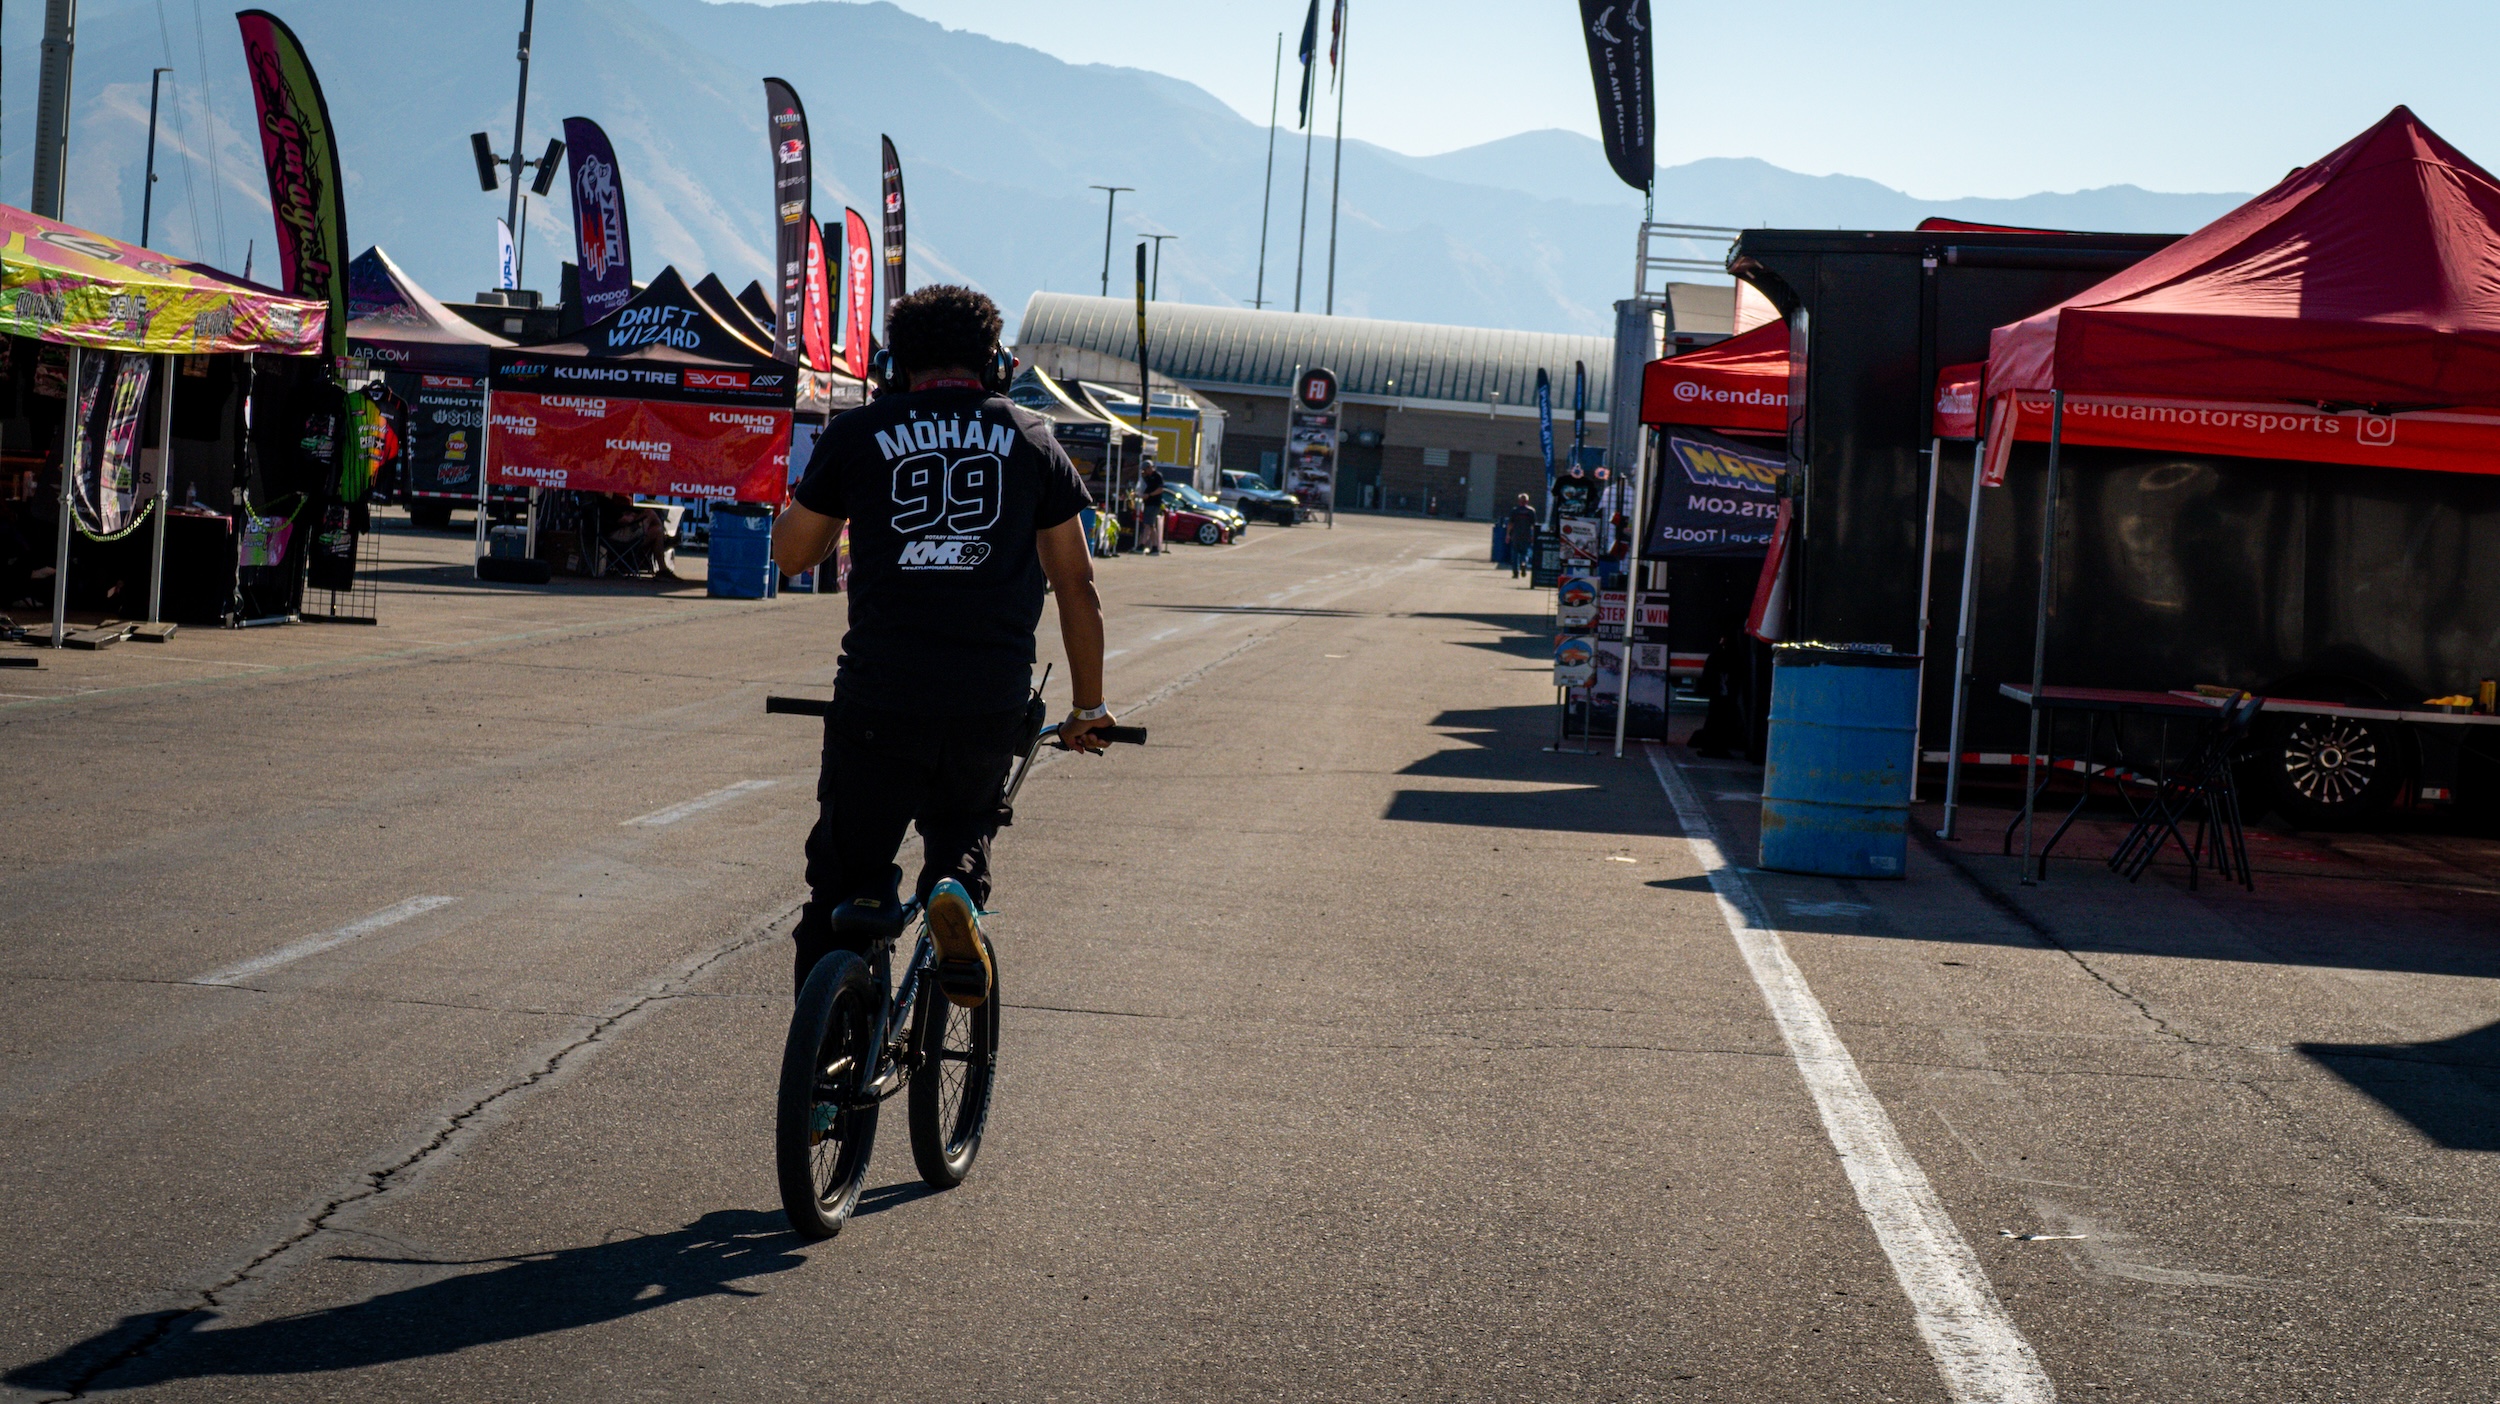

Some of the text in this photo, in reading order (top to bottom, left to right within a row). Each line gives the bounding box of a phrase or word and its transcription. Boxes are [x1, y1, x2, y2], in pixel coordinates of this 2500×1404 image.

[1605, 47, 1618, 75] U.S.
[1634, 65, 1642, 92] AIR
[1610, 76, 1622, 102] AIR
[1635, 94, 1644, 147] FORCE
[602, 189, 619, 265] LINK
[586, 288, 629, 304] VOODOO
[617, 305, 699, 329] DRIFT
[608, 325, 700, 349] WIZARD
[353, 347, 409, 362] AB.COM
[554, 367, 629, 382] KUMHO
[631, 370, 677, 385] TIRE
[1309, 380, 1326, 399] FD
[420, 395, 468, 407] KUMHO
[541, 395, 606, 409] KUMHO
[576, 408, 605, 418] TIRE
[709, 412, 775, 426] KUMHO
[909, 410, 983, 420] KYLE
[506, 426, 536, 436] TIRE
[744, 425, 774, 435] TIRE
[449, 441, 465, 449] TOP
[605, 438, 672, 453] KUMHO
[874, 419, 1016, 461] MOHAN
[640, 452, 671, 461] TIRE
[501, 465, 568, 480] KUMHO
[536, 478, 567, 488] TIRE
[670, 482, 736, 497] KUMHO
[891, 451, 1002, 534] 99
